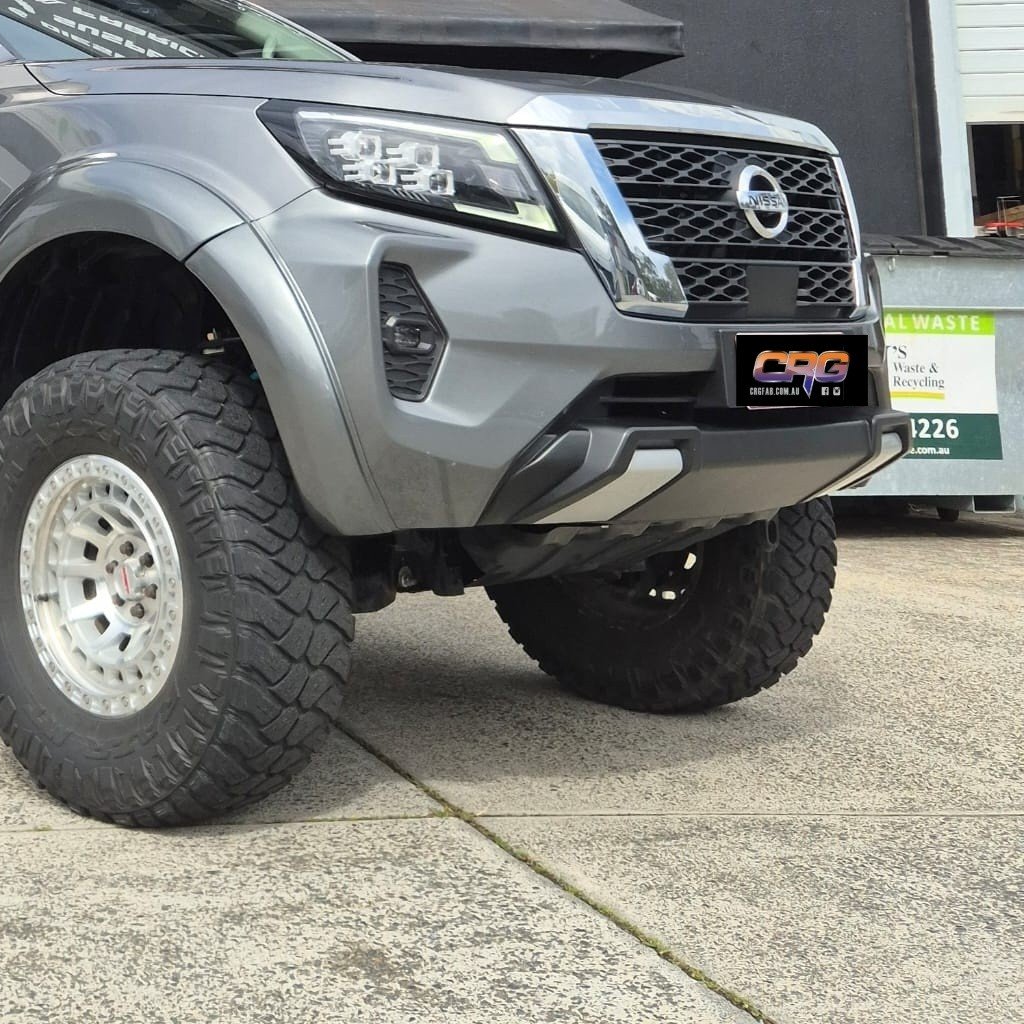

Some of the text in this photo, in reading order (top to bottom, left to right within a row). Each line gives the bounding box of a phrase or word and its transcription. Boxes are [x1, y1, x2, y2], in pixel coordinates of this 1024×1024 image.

[912, 314, 981, 331] WASTE
[893, 362, 939, 374] Waste &
[893, 375, 945, 389] Recycling
